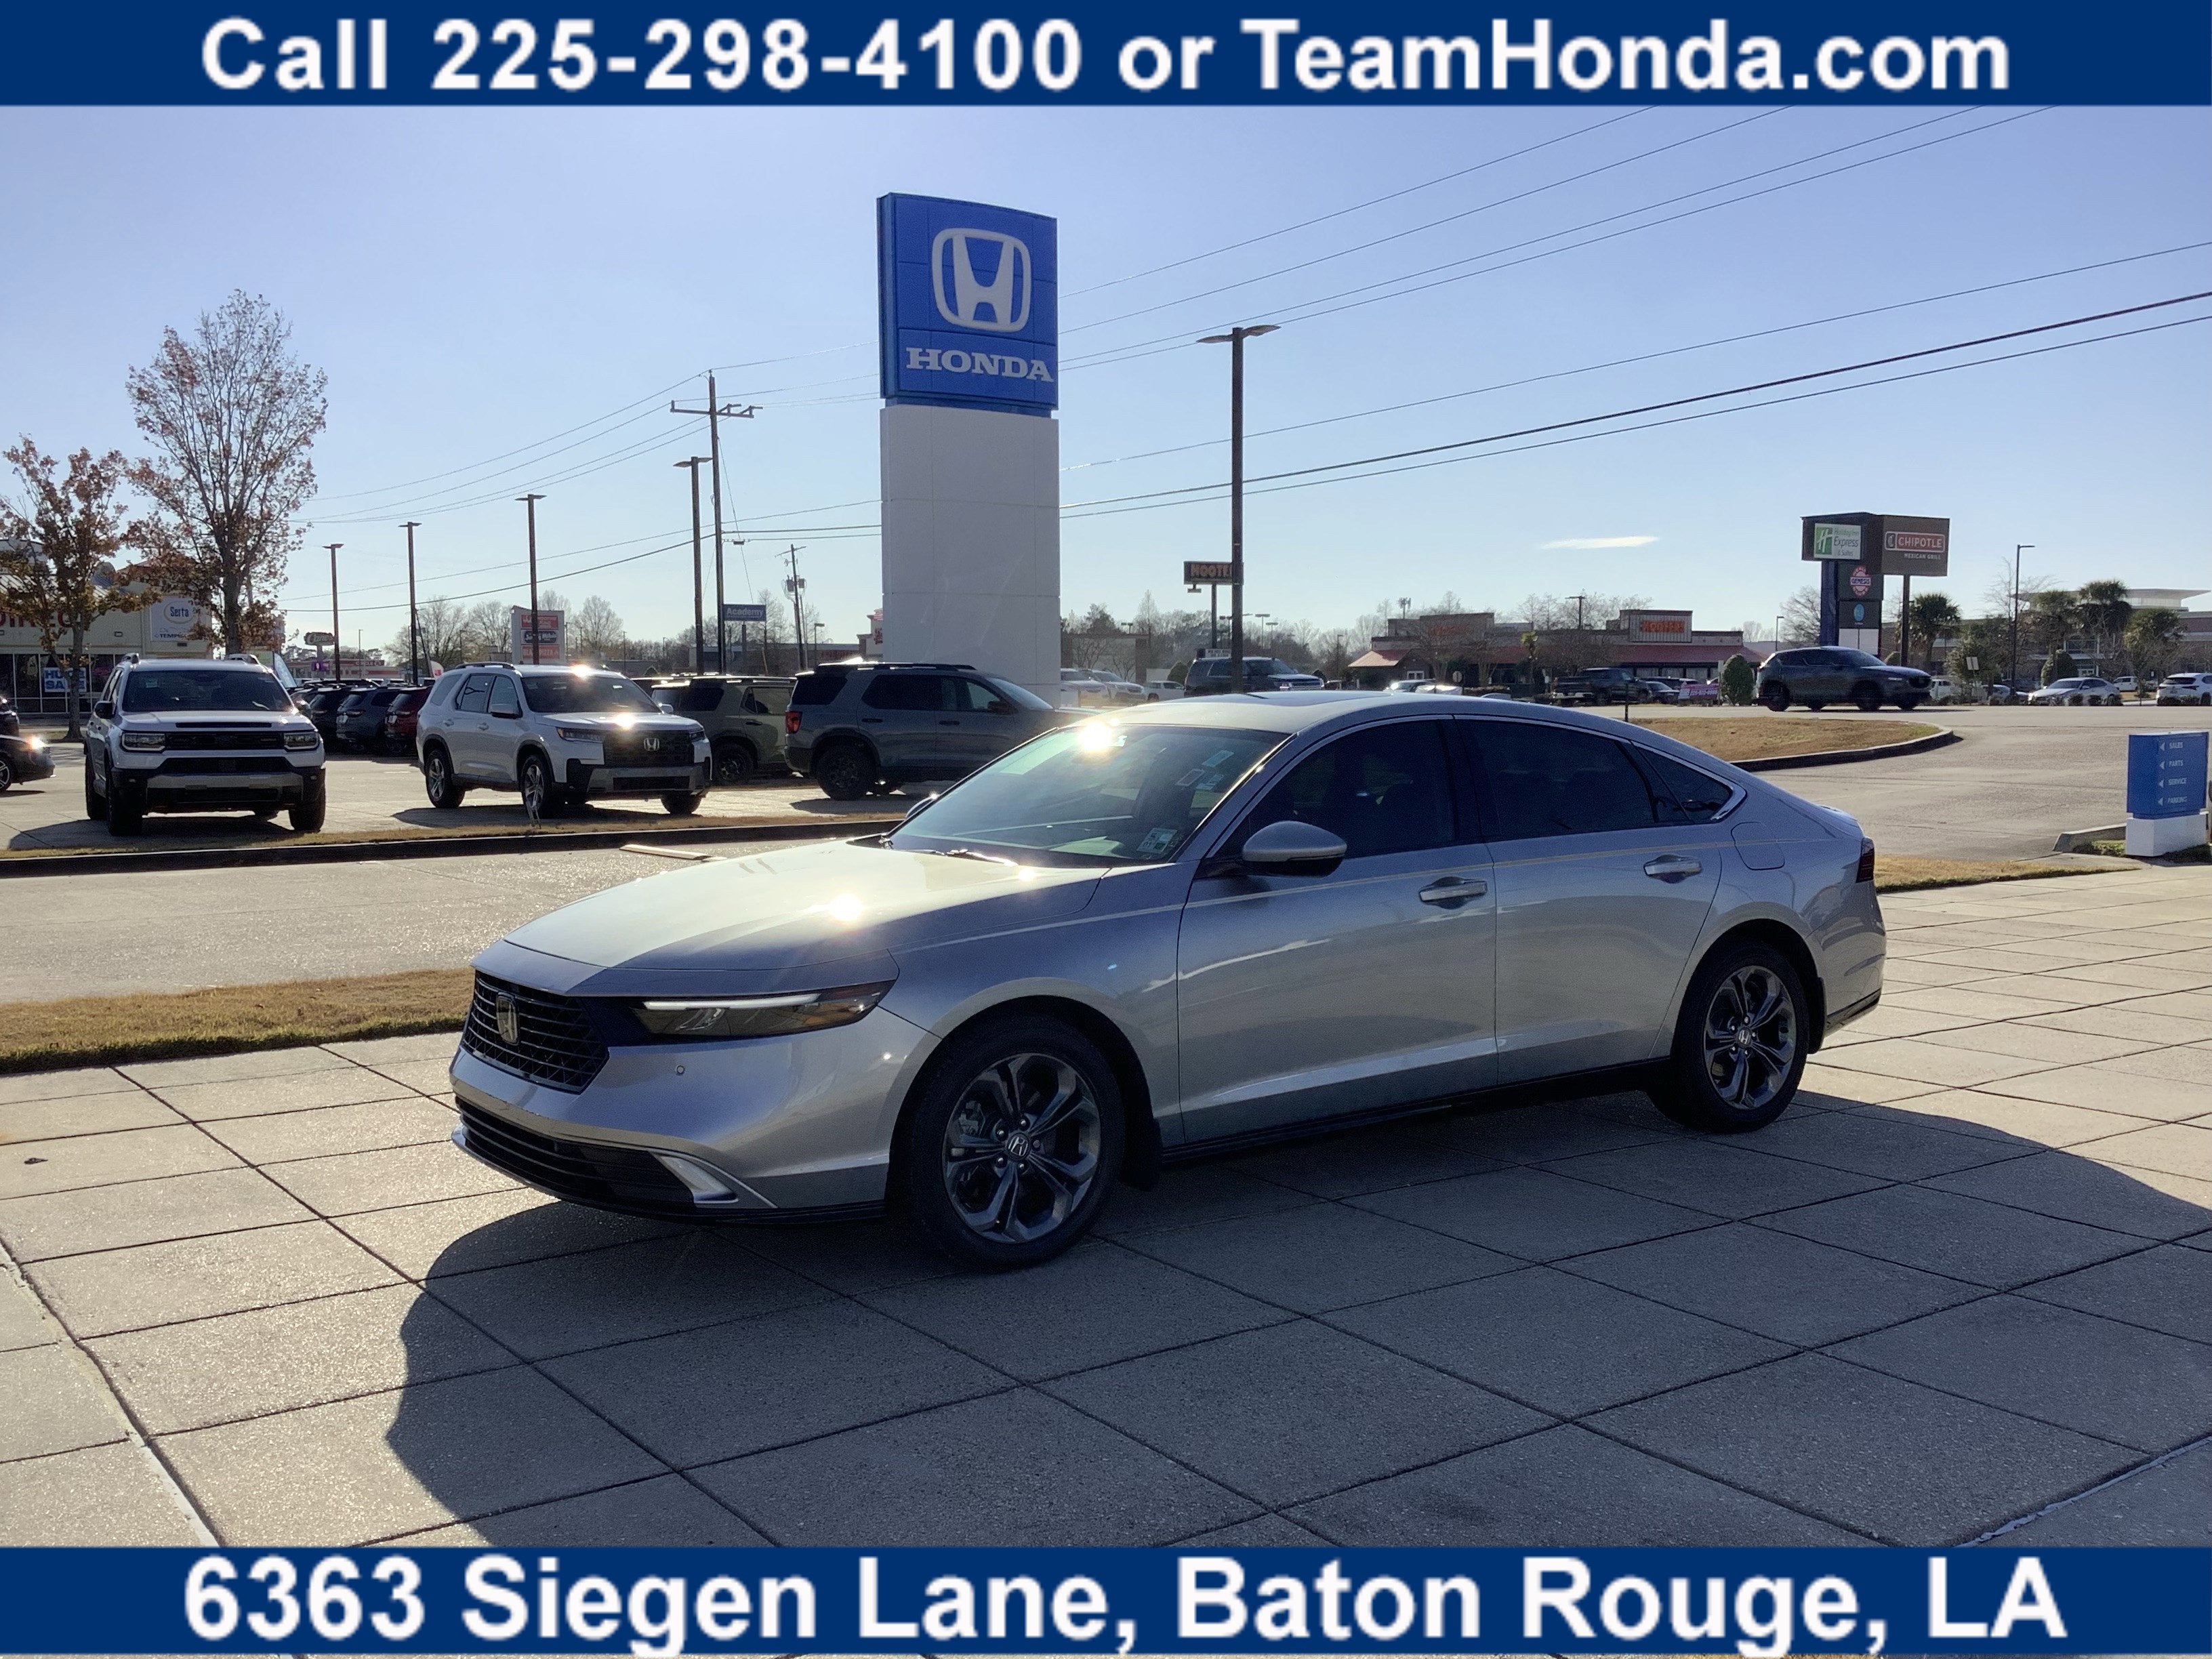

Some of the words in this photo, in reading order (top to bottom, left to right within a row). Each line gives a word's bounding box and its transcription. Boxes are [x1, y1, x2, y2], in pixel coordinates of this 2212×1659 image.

[906, 347, 1054, 382] HONDA
[1834, 536, 1859, 548] Express
[1898, 537, 1942, 548] CHIPOTLE
[1191, 564, 1233, 577] HOOTE
[170, 607, 189, 617] Serta
[726, 607, 763, 617] Academy
[45, 680, 85, 689] SAE
[2168, 777, 2187, 785] SERVICE
